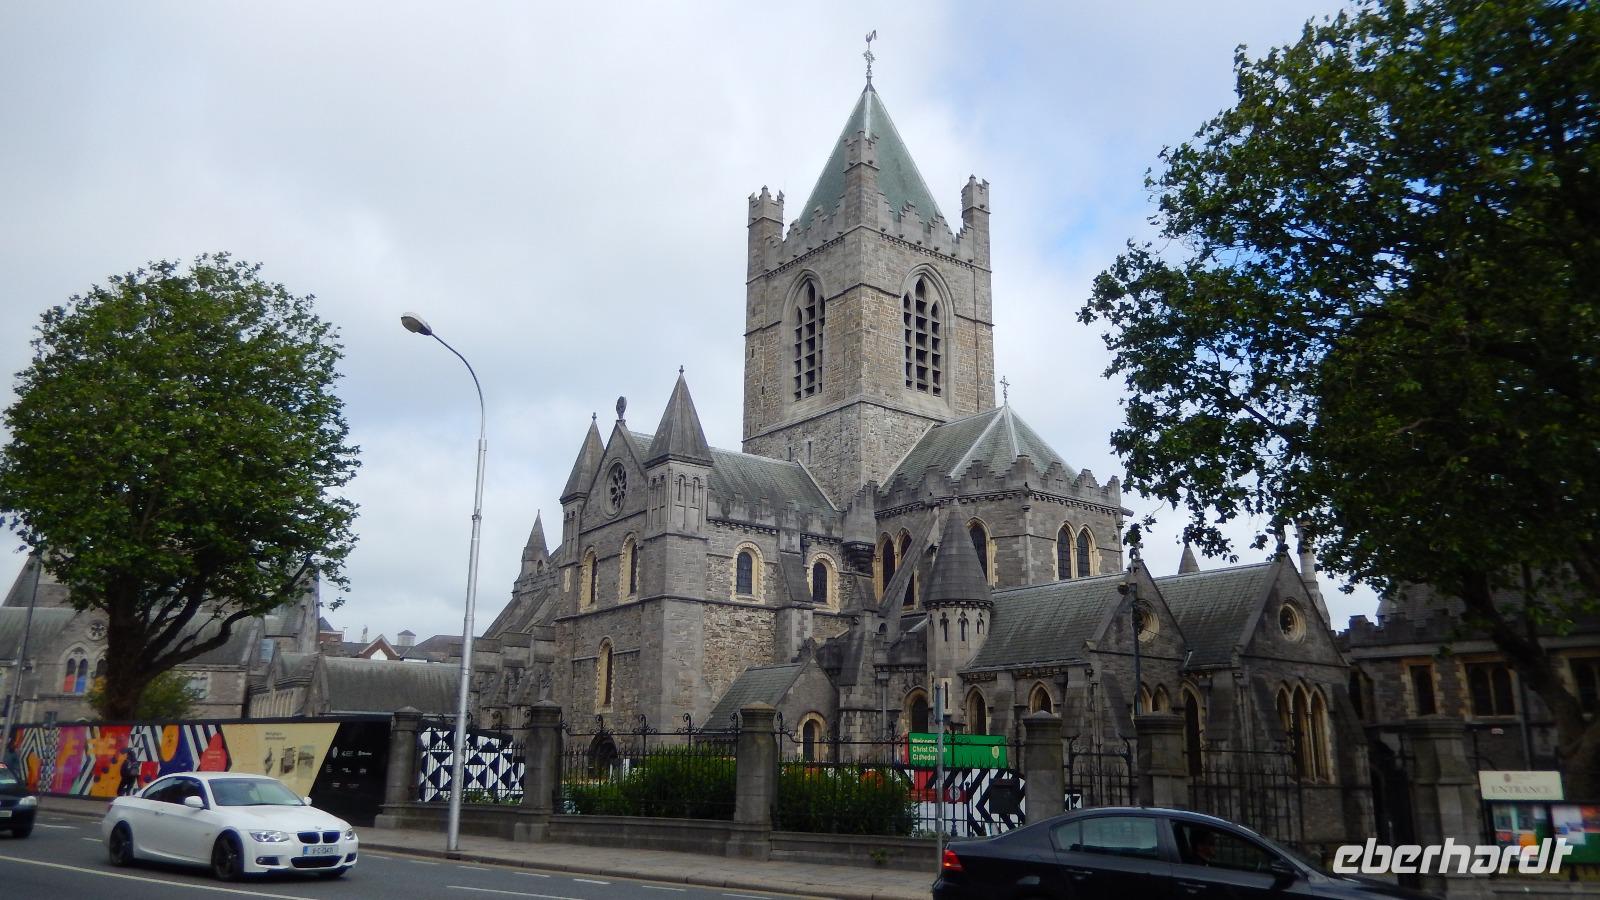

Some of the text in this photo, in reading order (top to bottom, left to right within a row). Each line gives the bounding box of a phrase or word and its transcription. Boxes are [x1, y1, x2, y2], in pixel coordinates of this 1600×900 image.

[912, 745, 948, 753] Christ Chuh
[912, 753, 937, 761] Cathedra
[1491, 784, 1552, 794] ENTRANCE
